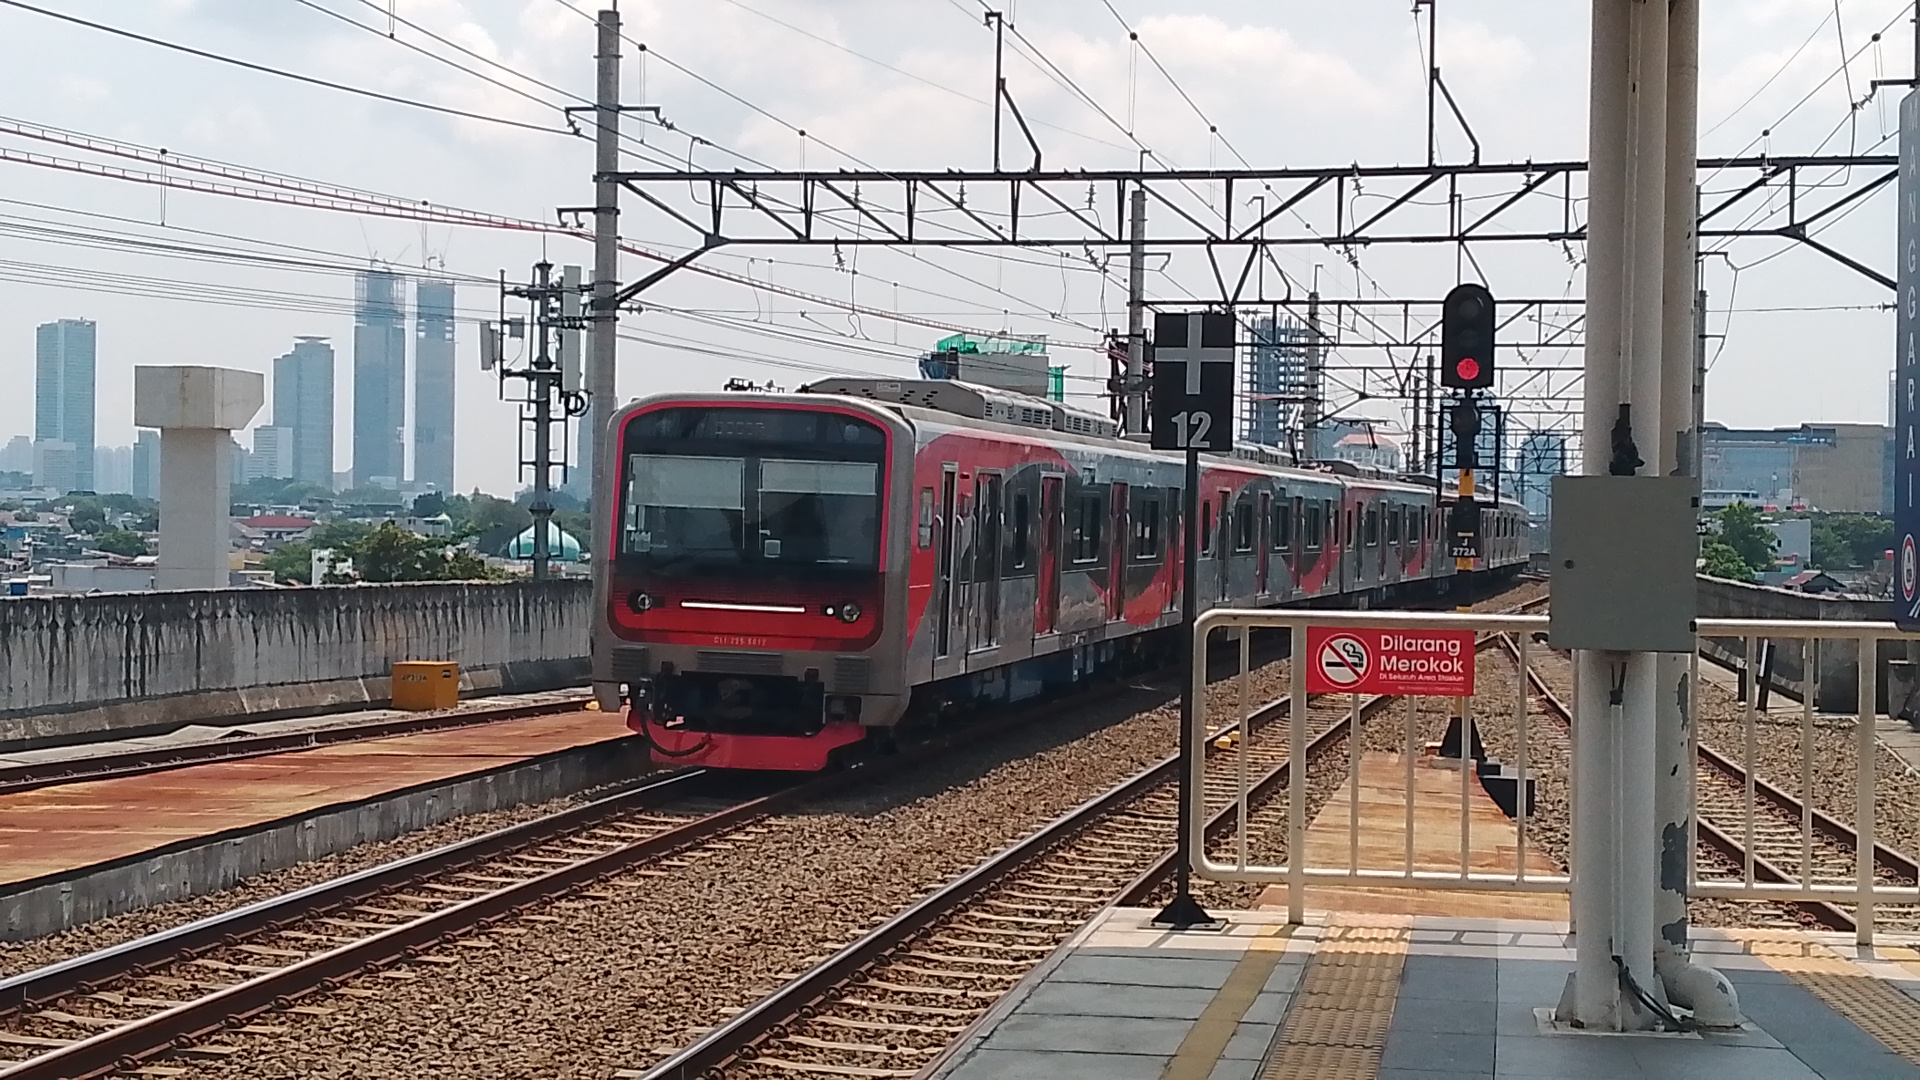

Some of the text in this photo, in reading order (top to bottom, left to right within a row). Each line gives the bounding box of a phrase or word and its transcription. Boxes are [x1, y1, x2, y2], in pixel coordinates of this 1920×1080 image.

[1906, 97, 1917, 507] MANGGARAI
[1171, 411, 1211, 448] 12
[1461, 538, 1468, 546] J
[1452, 547, 1477, 556] 272A
[1380, 634, 1461, 657] Dilarang
[1380, 655, 1464, 673] Merokok
[1388, 672, 1417, 681] Seluruh
[1417, 673, 1437, 681] Area
[1437, 674, 1465, 682] Stasiun
